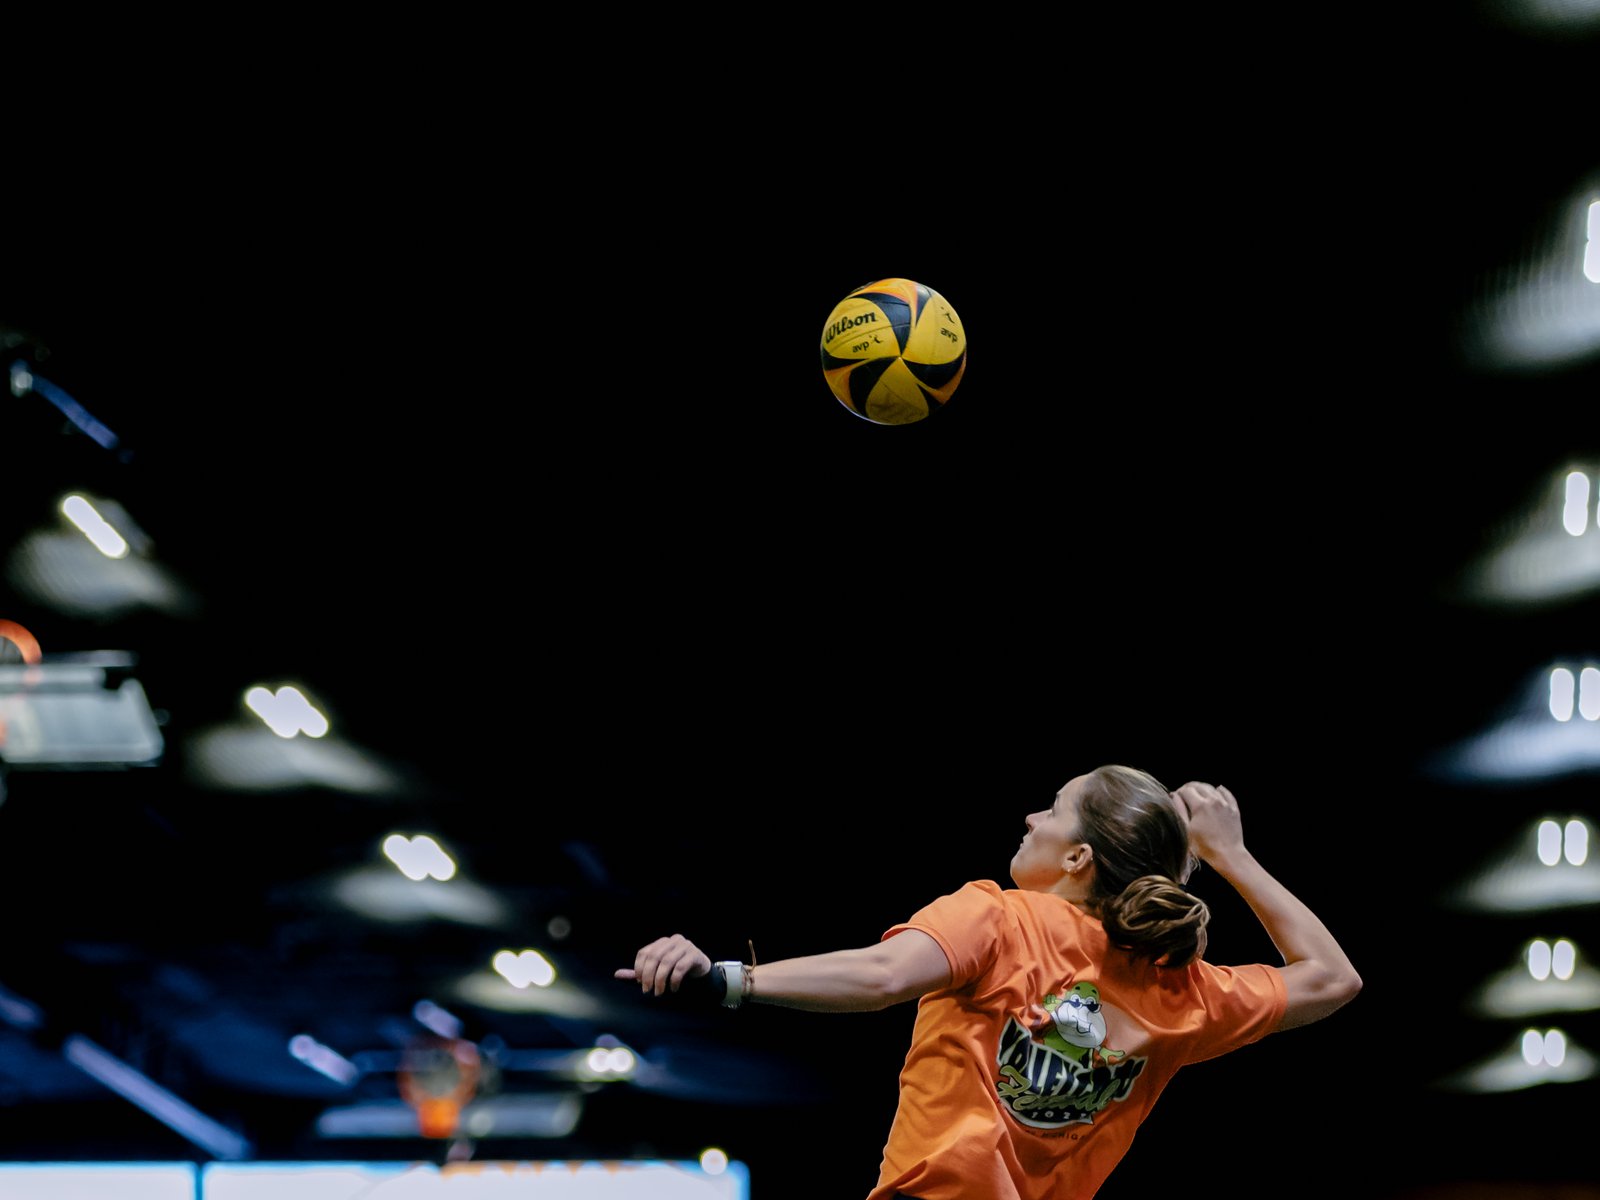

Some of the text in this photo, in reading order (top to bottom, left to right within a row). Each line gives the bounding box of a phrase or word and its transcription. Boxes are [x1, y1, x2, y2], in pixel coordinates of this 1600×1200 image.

[825, 311, 877, 344] Wilson
[940, 327, 959, 343] avp
[852, 341, 870, 353] avp
